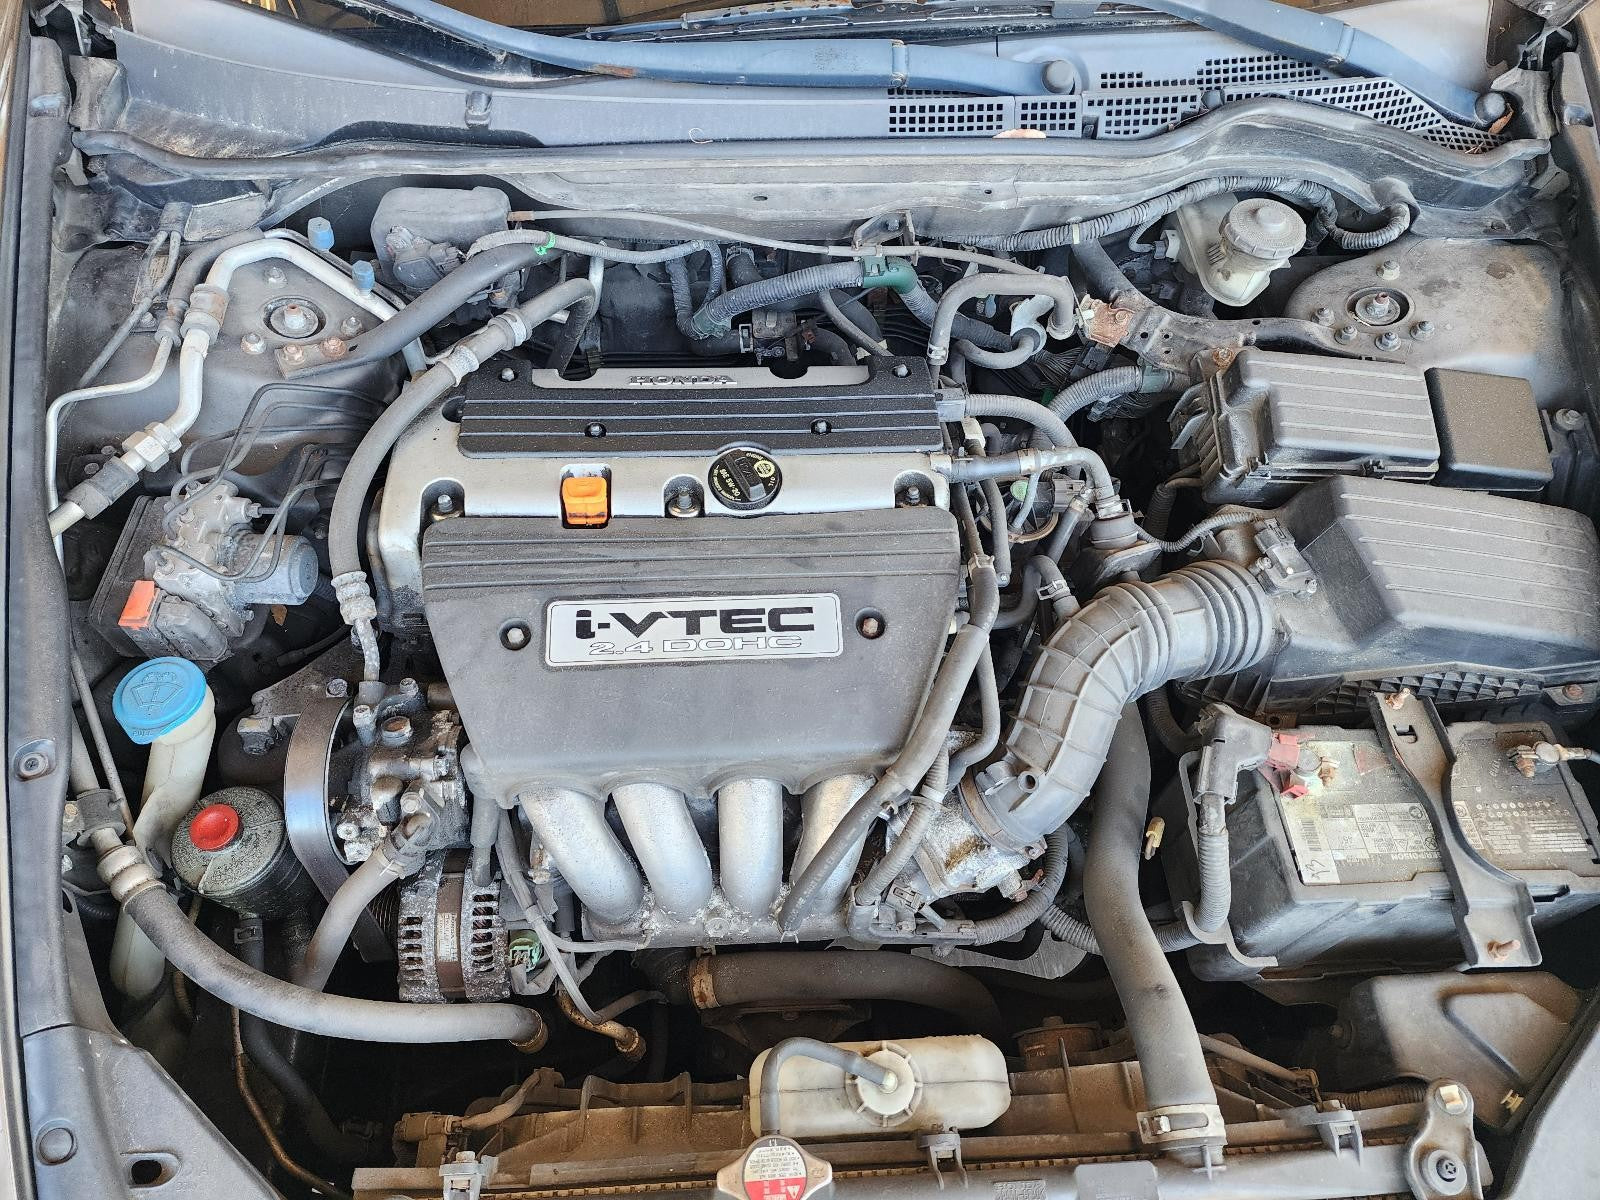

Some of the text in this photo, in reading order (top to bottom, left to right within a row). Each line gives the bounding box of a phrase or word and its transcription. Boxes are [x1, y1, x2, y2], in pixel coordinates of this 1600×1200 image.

[629, 375, 738, 385] HONDA
[720, 468, 730, 479] SAE
[726, 477, 741, 497] 5W-20
[768, 476, 776, 487] OIL
[575, 606, 815, 640] i-VTEC
[589, 635, 802, 656] 2.4 DOHC
